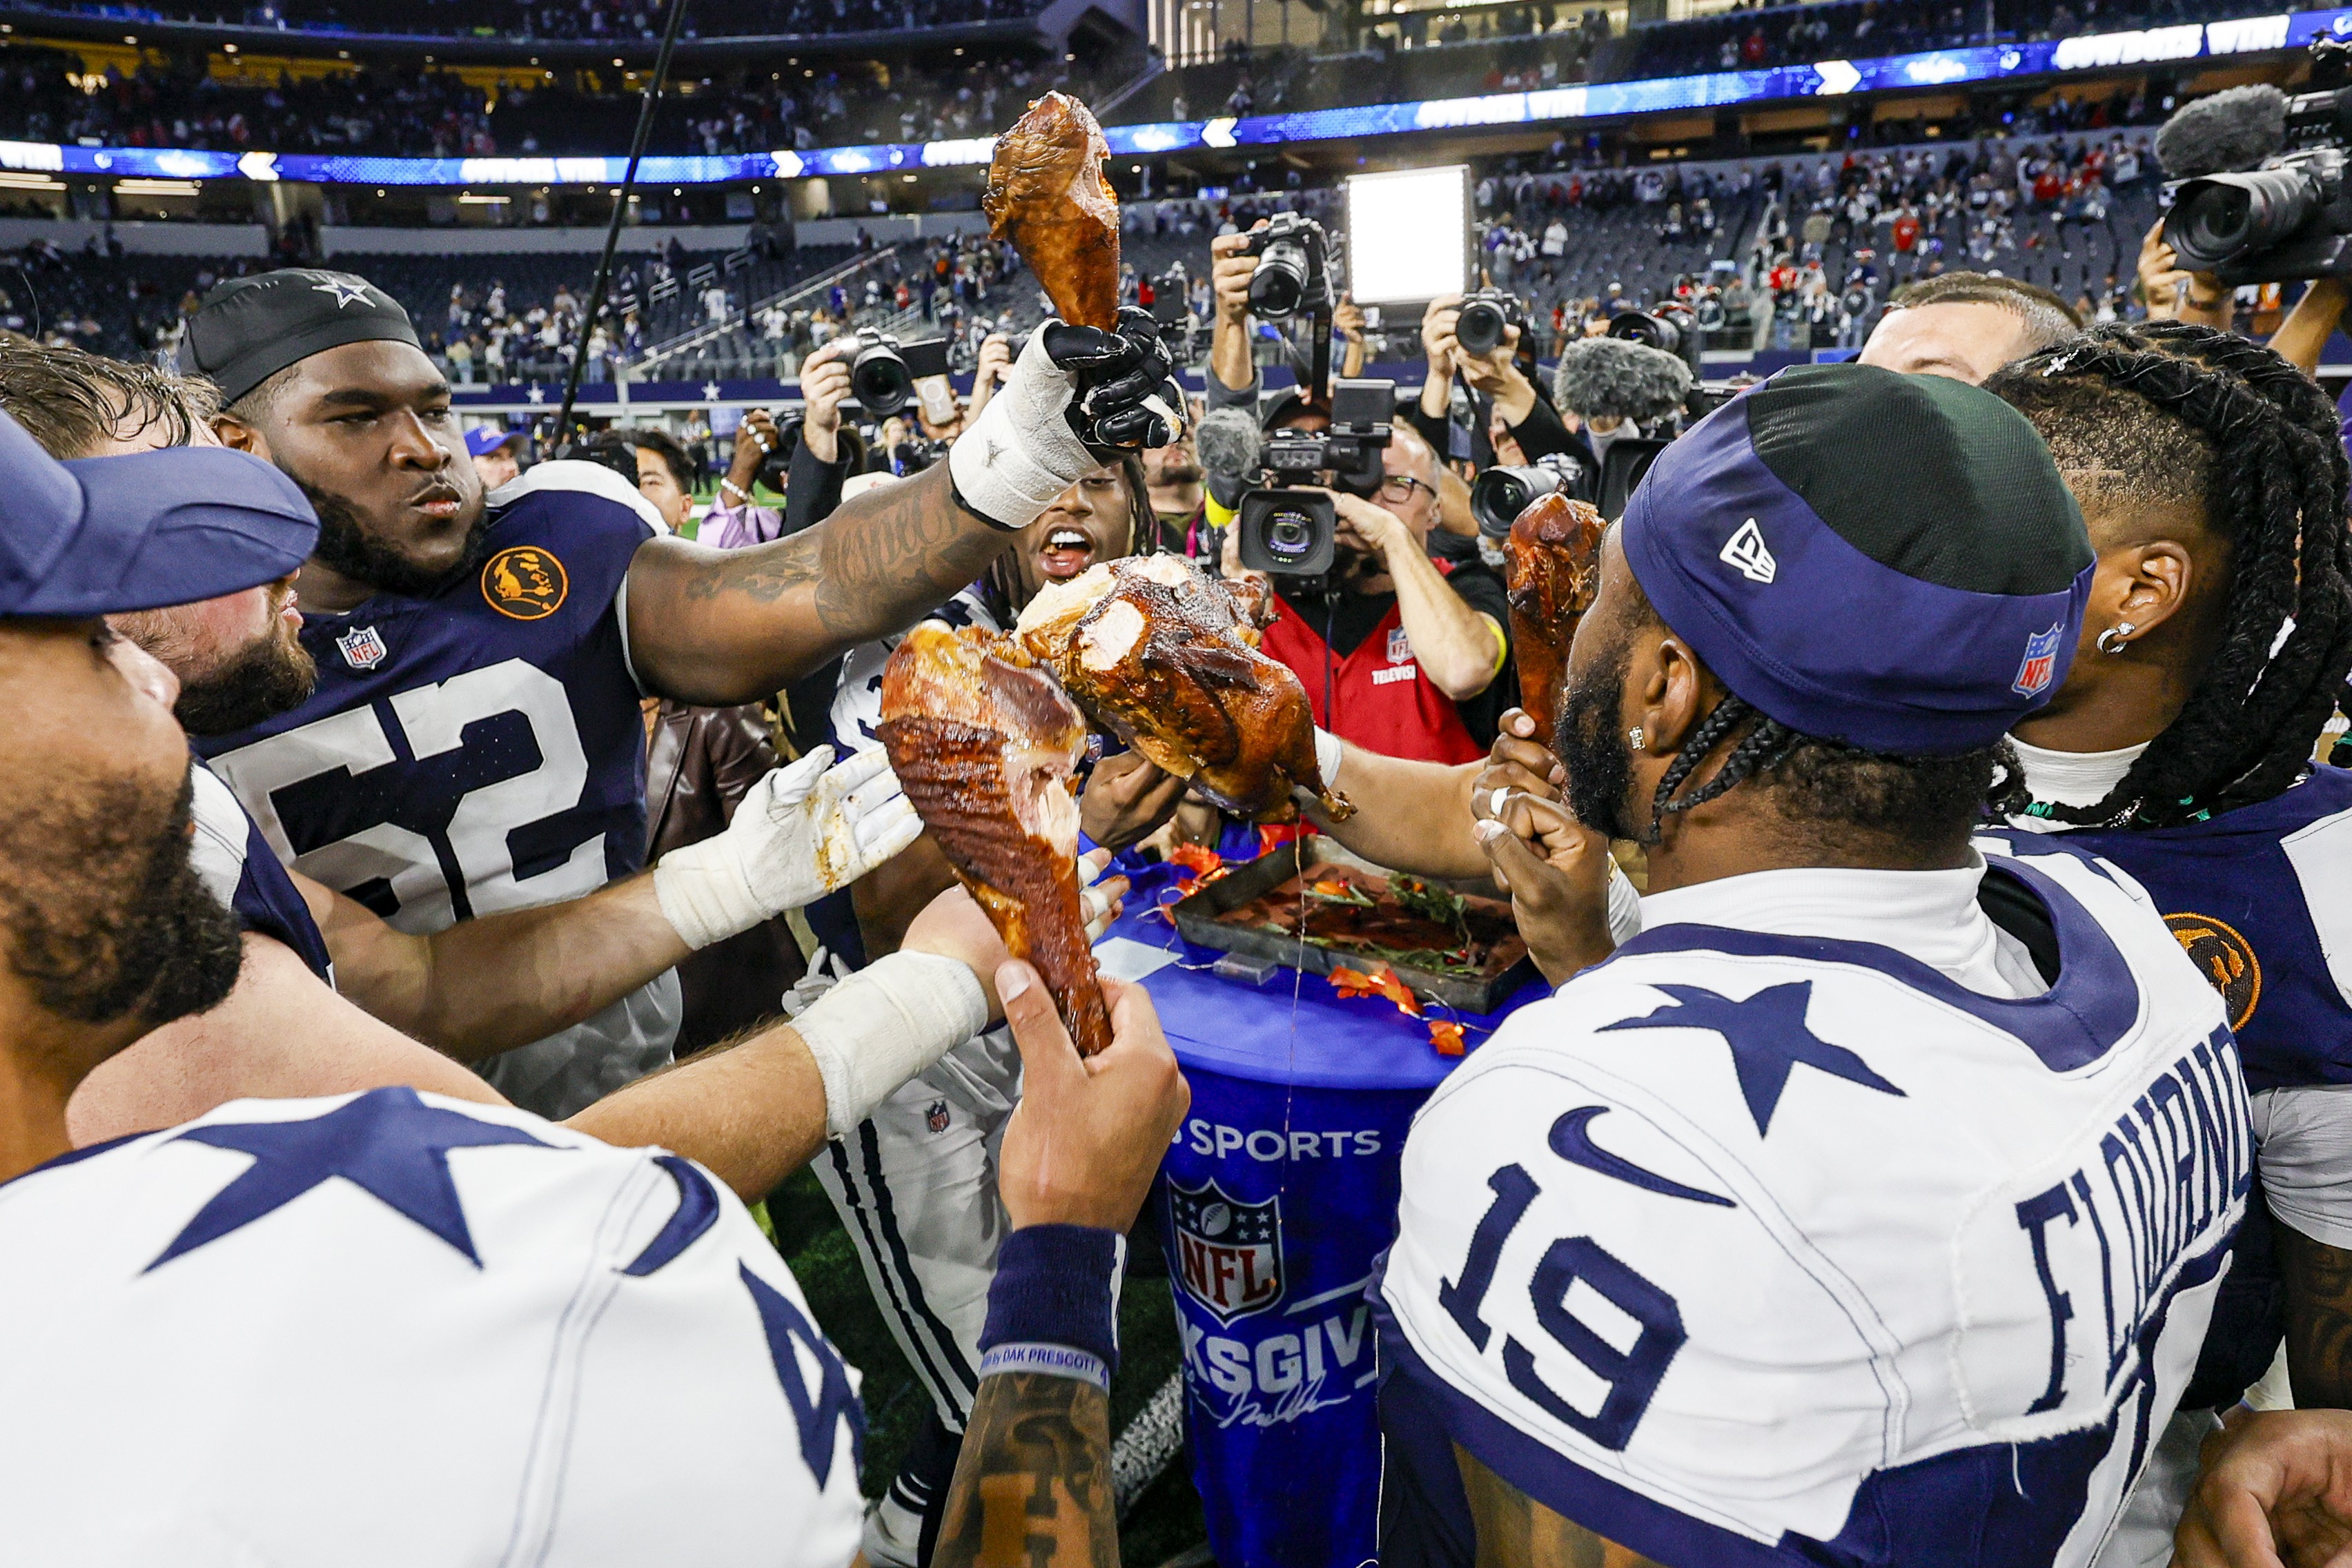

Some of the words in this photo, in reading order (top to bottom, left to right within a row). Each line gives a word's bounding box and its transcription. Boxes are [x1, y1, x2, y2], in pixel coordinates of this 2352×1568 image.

[349, 642, 380, 663] NFL
[2017, 656, 2052, 689] NFL
[1371, 665, 1415, 685] TELEVISI
[206, 656, 608, 937] 52
[1189, 1118, 1382, 1162] SPORTS
[1179, 1231, 1272, 1309] NFL
[1438, 1162, 1689, 1452] 19
[1002, 1346, 1026, 1364] DAK
[1179, 1305, 1369, 1394] KSGIV
